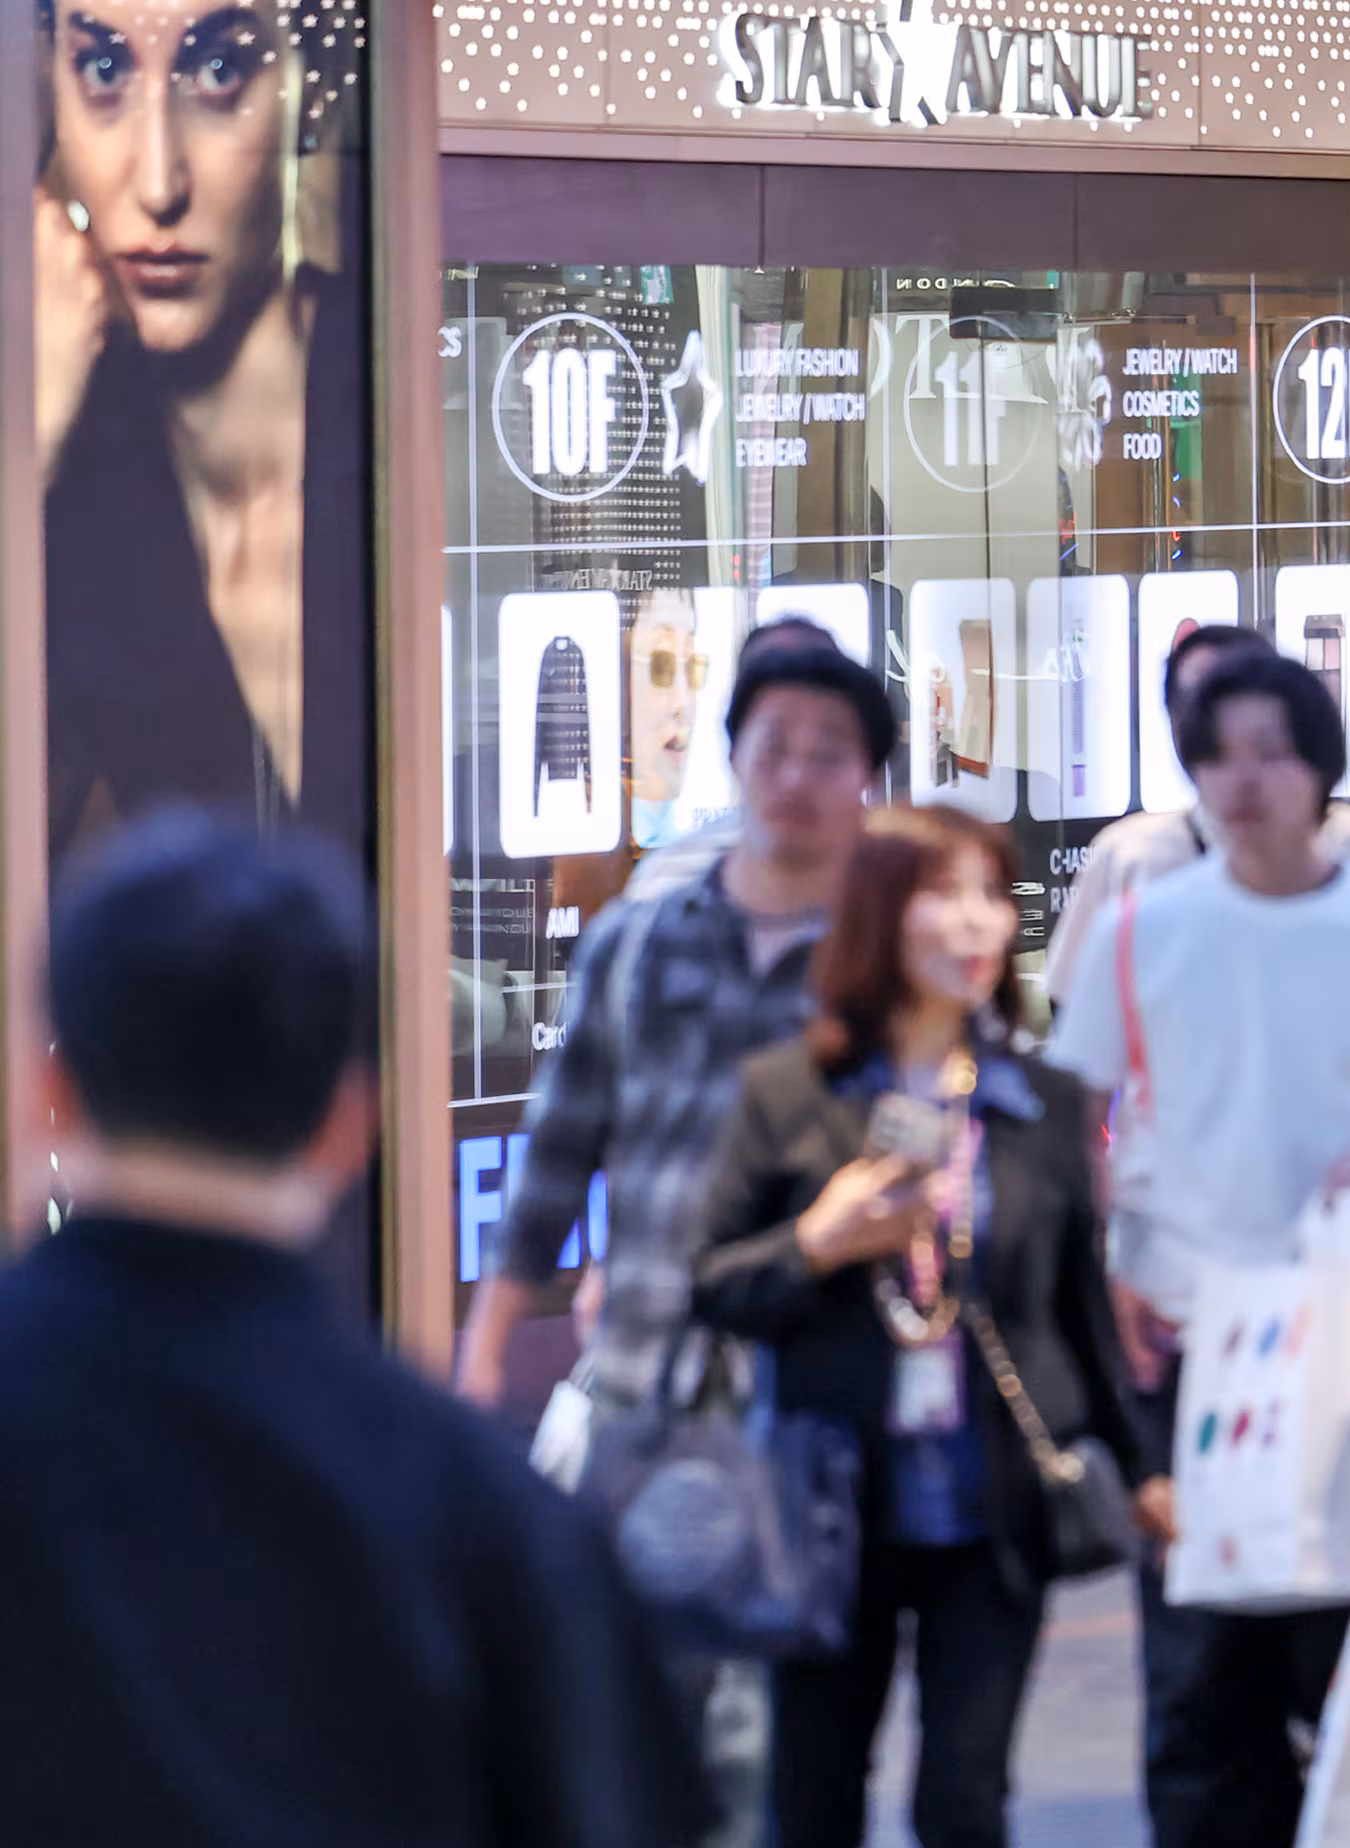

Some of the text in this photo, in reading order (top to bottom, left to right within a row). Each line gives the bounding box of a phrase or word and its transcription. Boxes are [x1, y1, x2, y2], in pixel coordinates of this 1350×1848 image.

[945, 23, 1152, 121] AVENUE
[798, 348, 859, 377] FASHION
[522, 347, 617, 475] 10F
[1122, 390, 1200, 418] COSMETICS
[735, 437, 808, 467] EYEWEAR
[1122, 432, 1162, 460] FOOD
[546, 906, 580, 939] AMI
